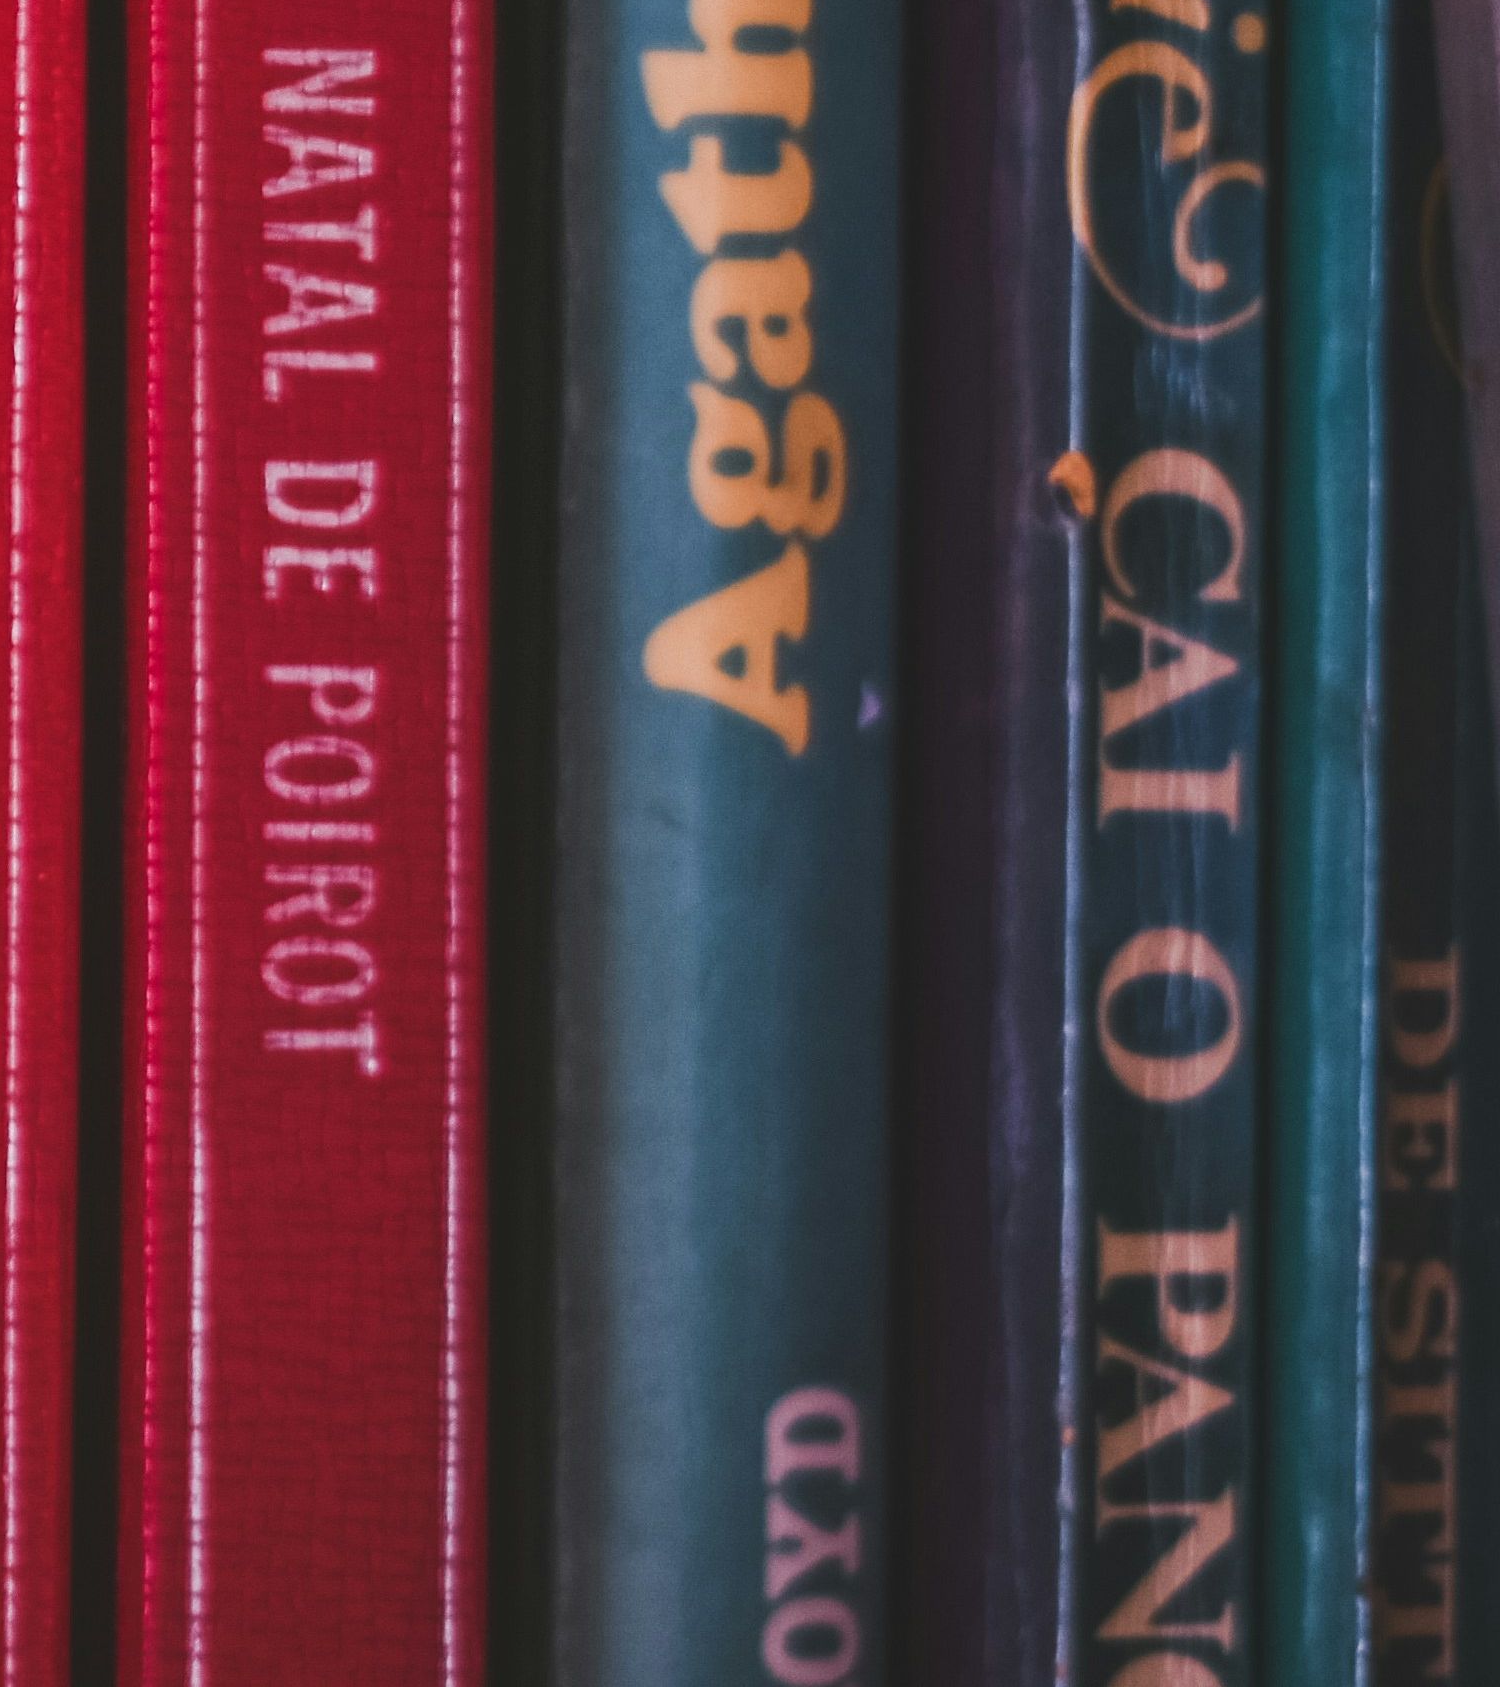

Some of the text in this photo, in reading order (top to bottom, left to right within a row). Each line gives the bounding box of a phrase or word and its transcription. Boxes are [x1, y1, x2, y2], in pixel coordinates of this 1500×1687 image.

[259, 47, 380, 404] NATAL
[259, 457, 380, 603] DE
[1094, 447, 1247, 833] CAI
[258, 664, 380, 1074] POIROT
[1097, 927, 1241, 1105] O
[1385, 944, 1463, 1194] DE
[760, 1383, 864, 1687] OYD
